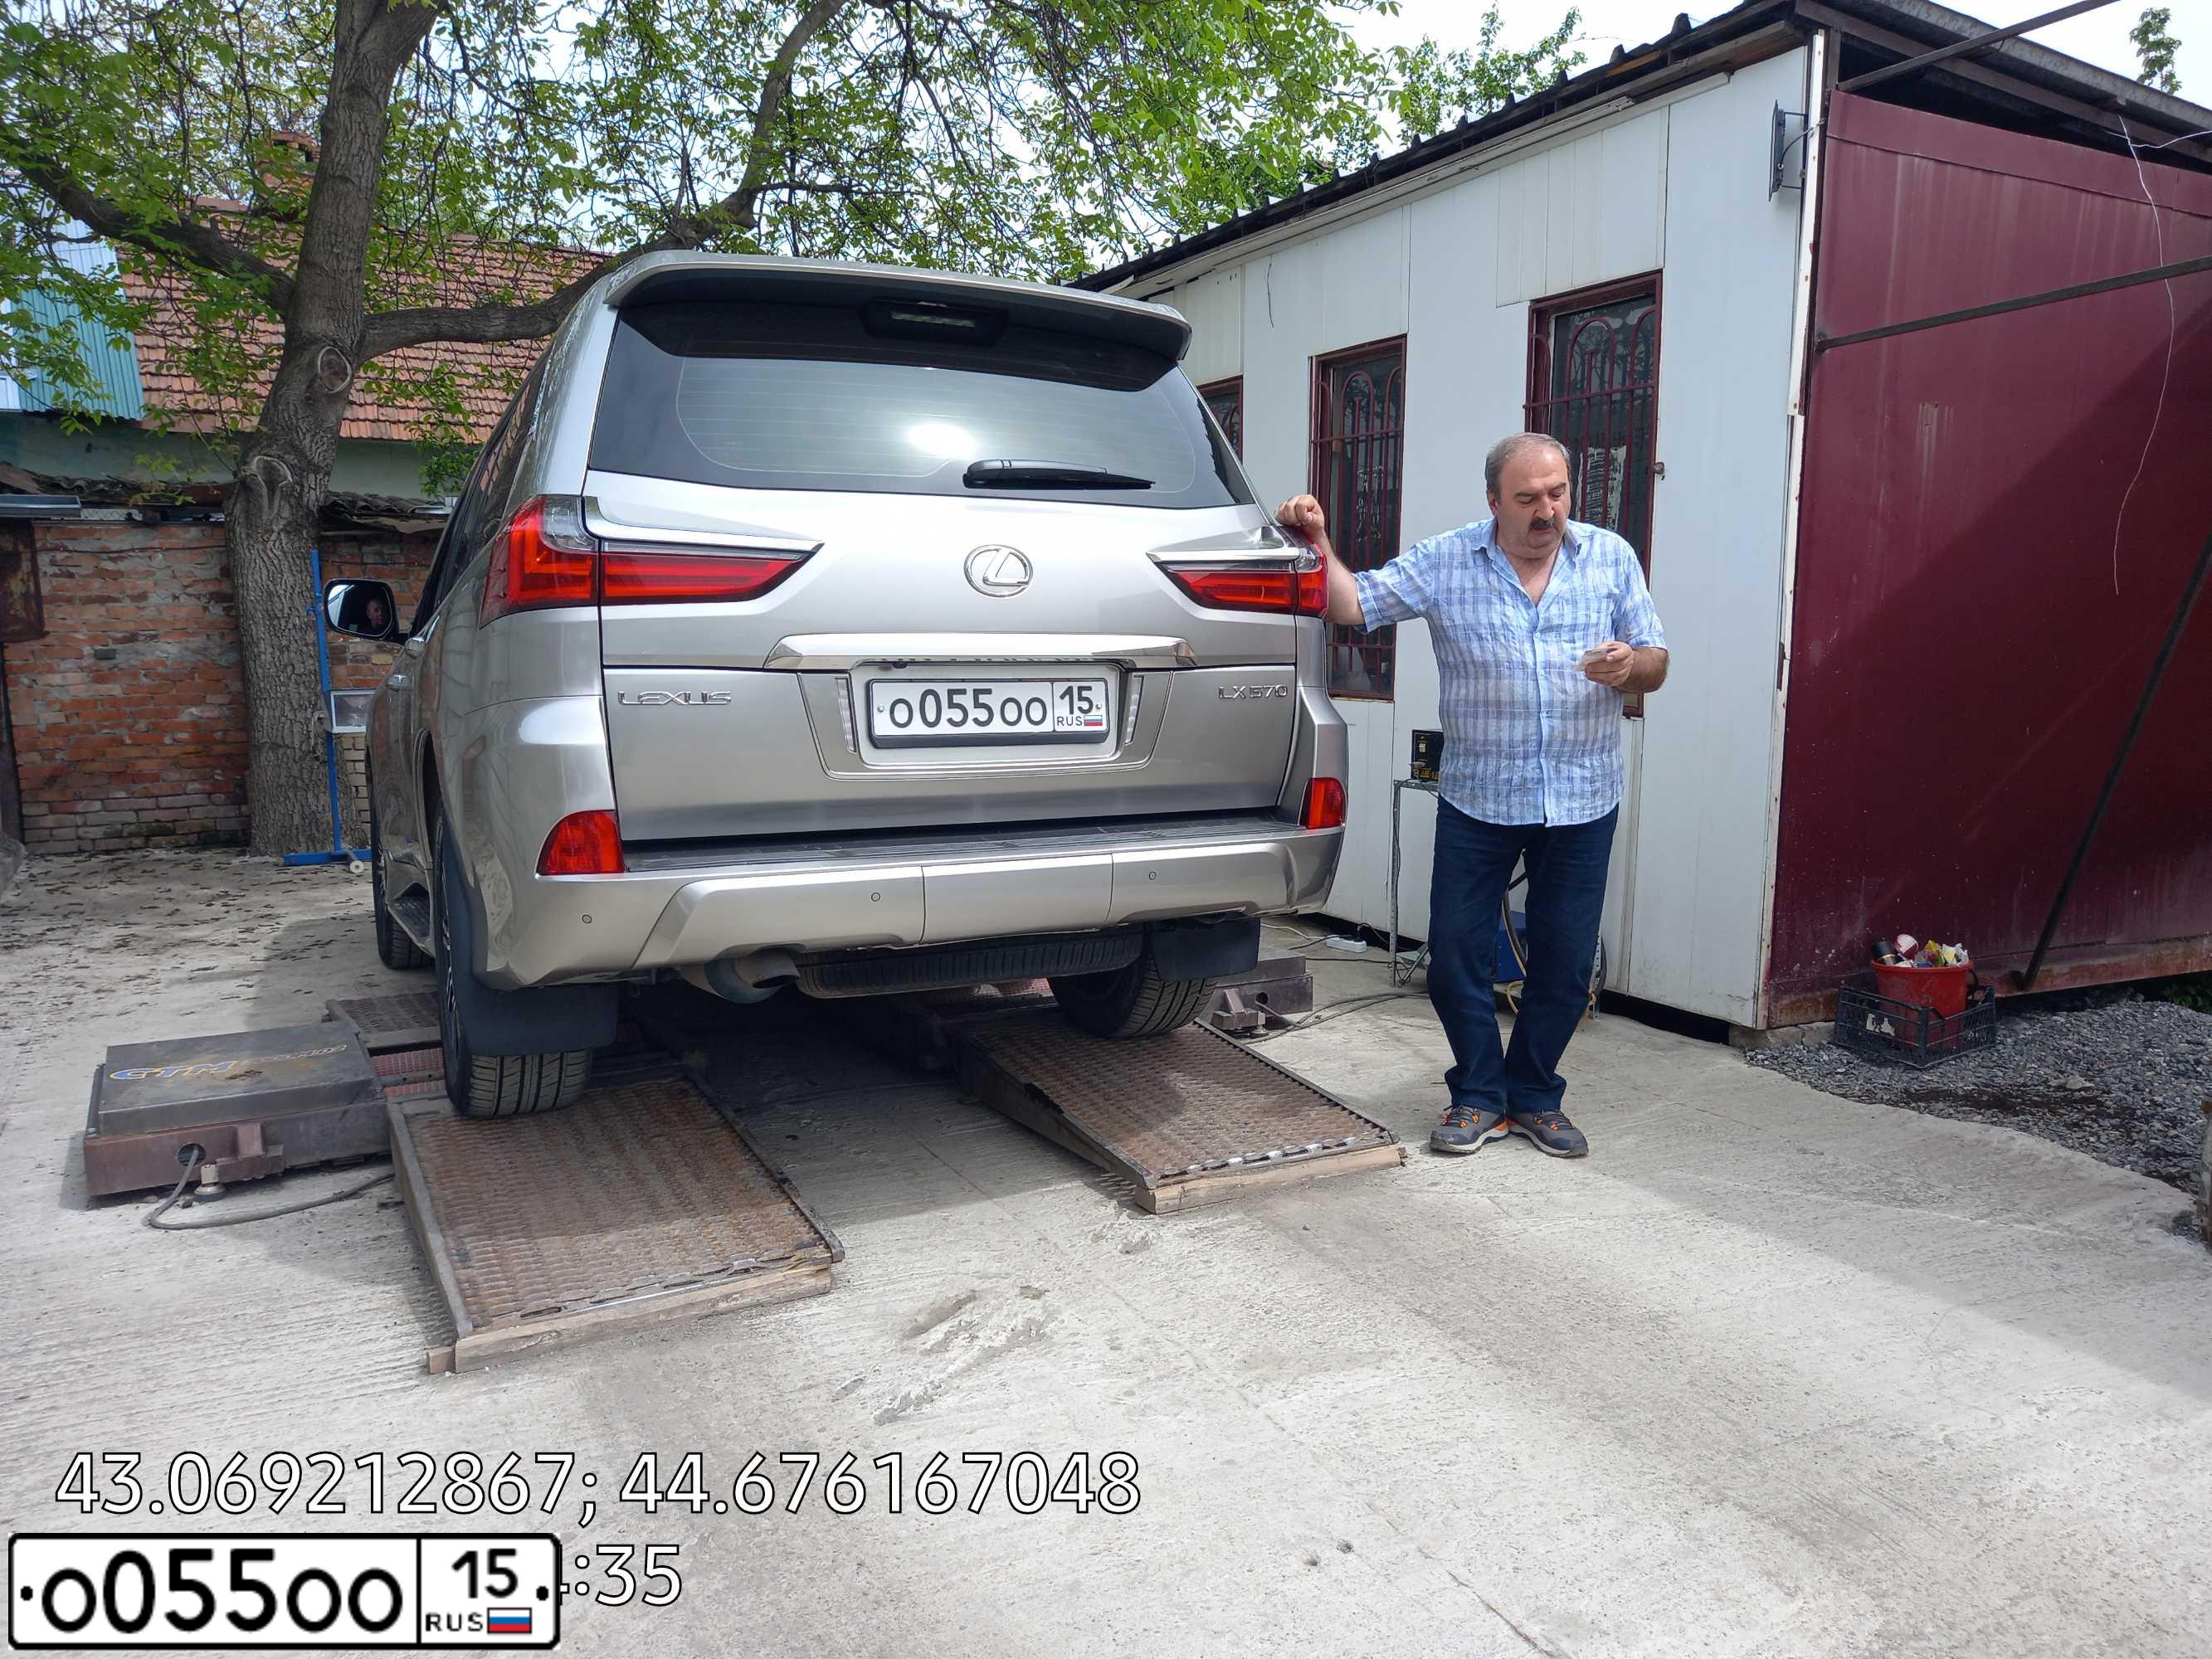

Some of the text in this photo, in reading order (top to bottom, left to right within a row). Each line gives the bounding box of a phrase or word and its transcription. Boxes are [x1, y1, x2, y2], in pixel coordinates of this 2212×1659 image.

[617, 690, 732, 705] LEXUS
[1218, 684, 1289, 698] LX 570
[1059, 685, 1094, 714] 15
[1056, 715, 1083, 727] RUS
